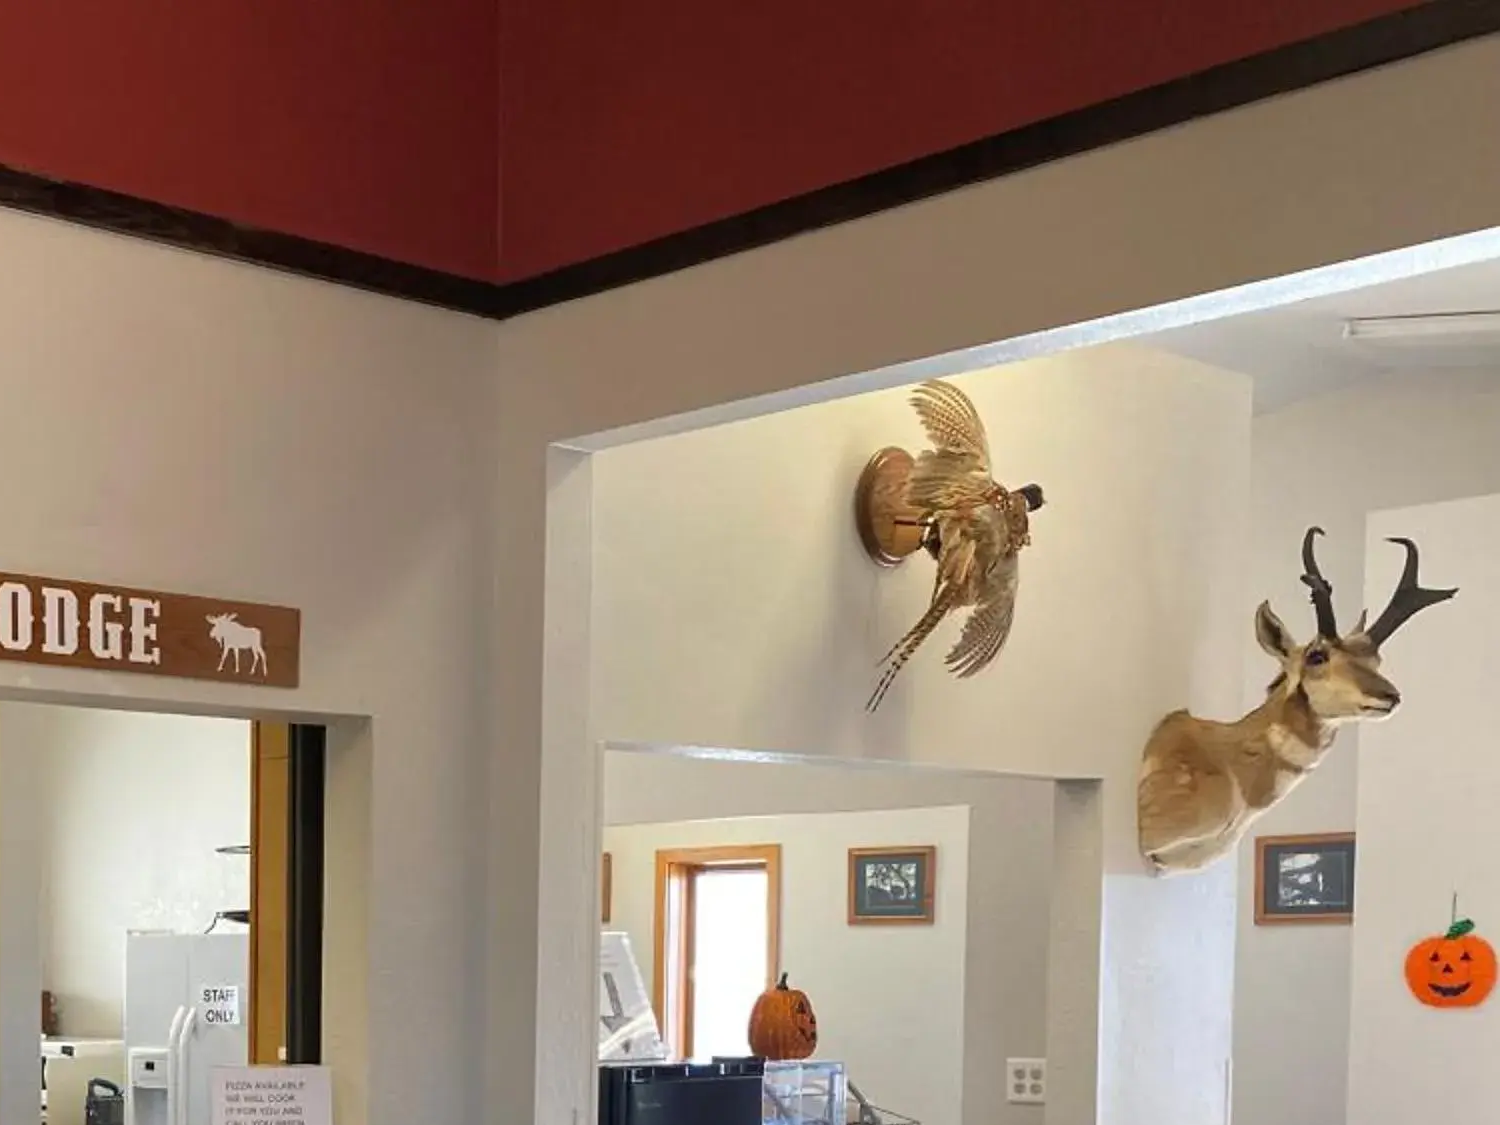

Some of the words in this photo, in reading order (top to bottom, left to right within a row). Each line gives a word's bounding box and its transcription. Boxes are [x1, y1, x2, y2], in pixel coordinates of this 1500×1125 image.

[206, 1009, 234, 1022] ONLY
[225, 1080, 253, 1091] PIZZA
[255, 1080, 305, 1090] AVAILABLE
[259, 1107, 280, 1116] YOU
